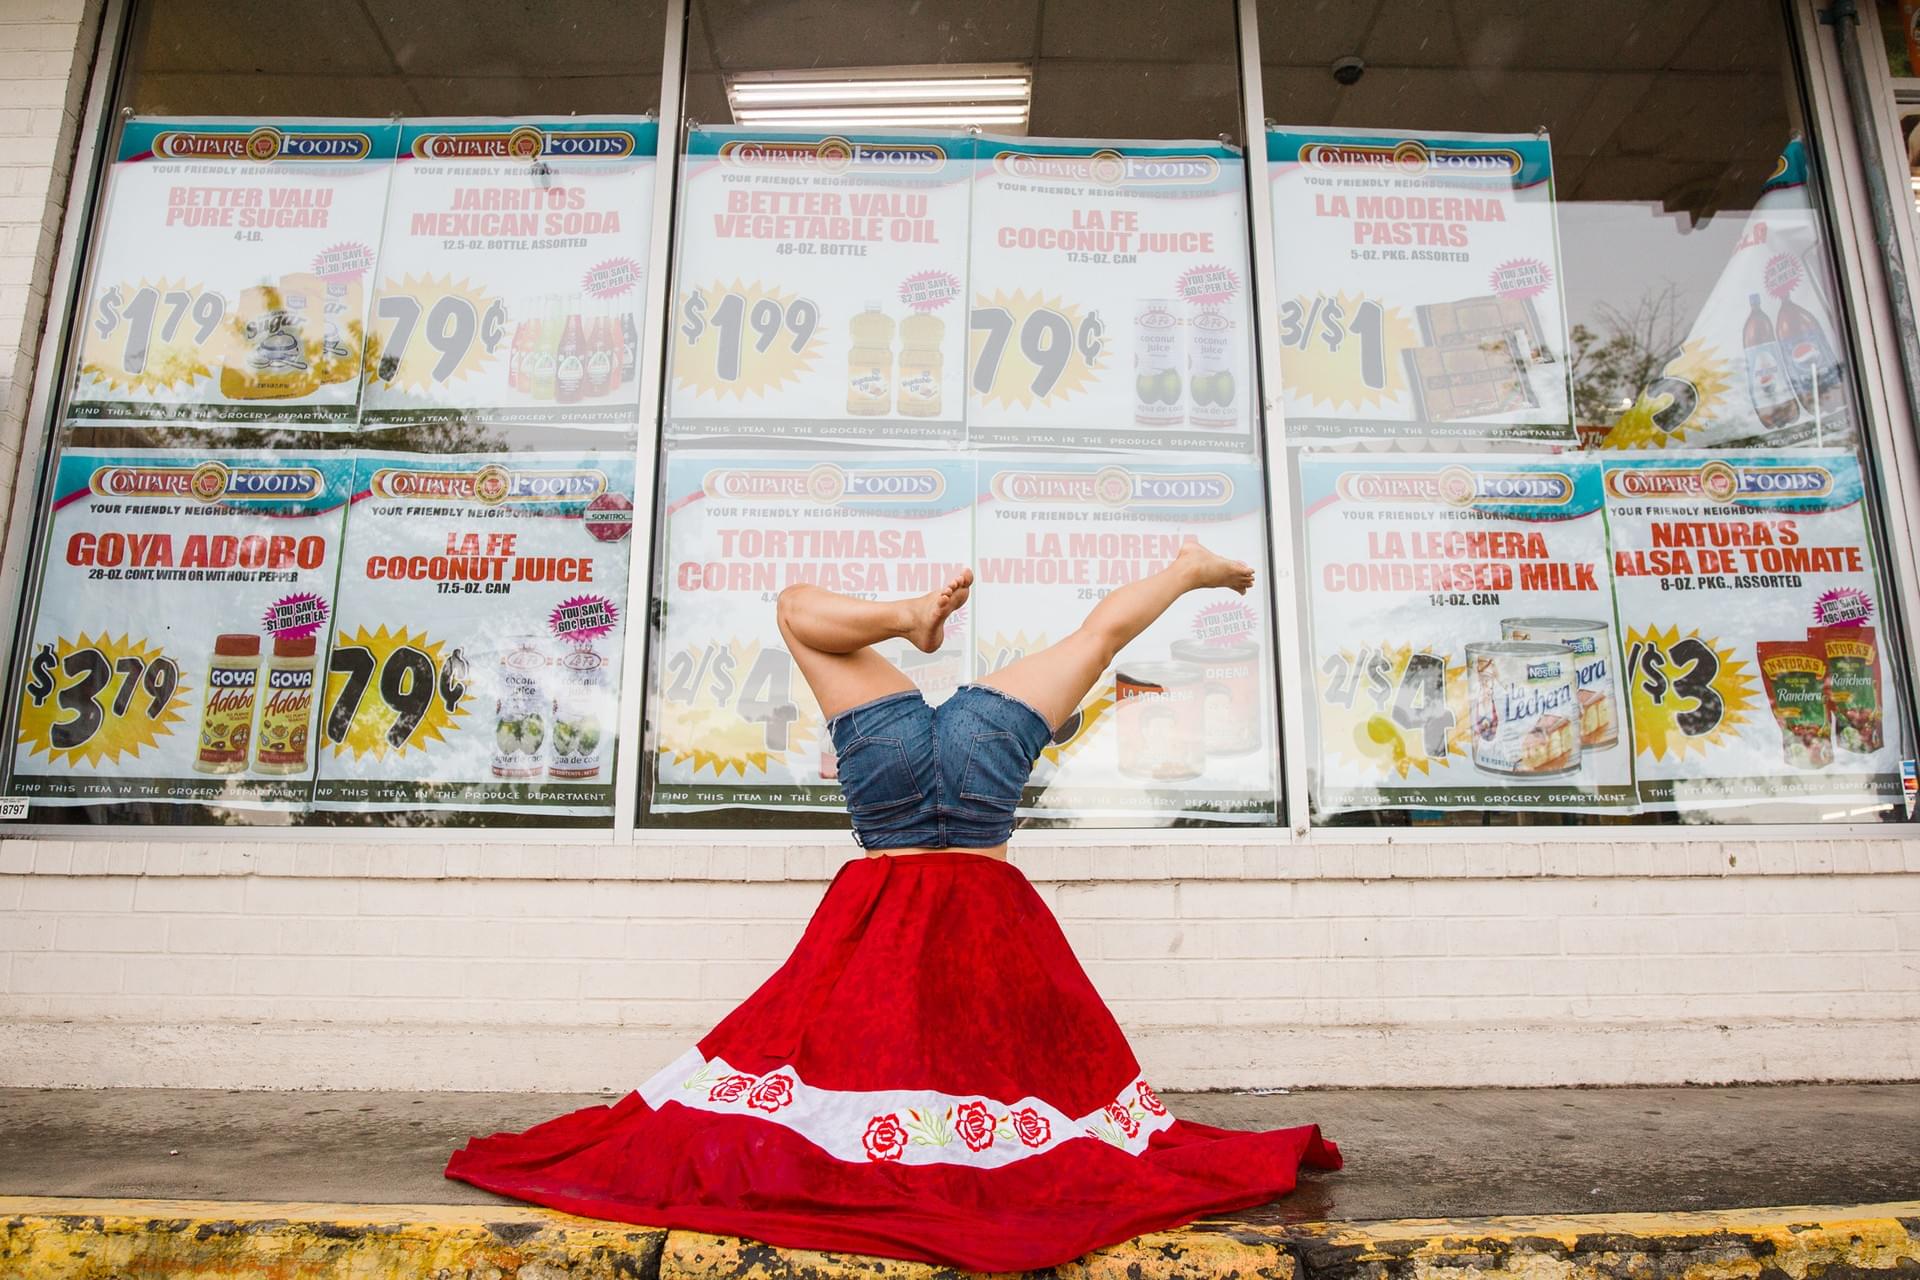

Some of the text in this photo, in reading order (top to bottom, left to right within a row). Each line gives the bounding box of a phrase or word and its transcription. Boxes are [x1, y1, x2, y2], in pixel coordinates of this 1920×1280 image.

[163, 134, 359, 157] COMPARE FOODS
[424, 134, 623, 159] COMPARE FOODS
[730, 143, 934, 166] COMPARE FOODS
[1005, 155, 1208, 180] COMPARE FOODS
[1309, 145, 1511, 170] COMPARE FOODS
[168, 187, 334, 208] BETTER VALU
[450, 188, 585, 211] JARRITOS
[728, 190, 927, 218] BETTER VALU
[1315, 194, 1506, 222] LA MODERNA
[166, 208, 328, 228] PURE SUGAR
[411, 212, 620, 236] MEXICAN SODA
[714, 214, 939, 244] VEGETABLE OIL
[1072, 210, 1138, 232] LA FE
[234, 232, 263, 242] 4-LB.
[532, 238, 587, 249] ASSORTED
[998, 228, 1214, 253] COCONUT JUICE
[1354, 222, 1468, 247] PASTAS
[776, 243, 868, 256] 48-OZ. BOTTLE
[1068, 252, 1136, 264] 17.5-OZ. CAN
[1350, 250, 1380, 260] 5-OZ.
[1411, 250, 1469, 263] ASSORTED
[101, 468, 311, 496] COMPARE FOODS
[382, 471, 596, 498] COMPARE FOODS
[714, 471, 933, 498] COMPARE FOODS
[1002, 474, 1220, 501] COMPARE FOODS
[1350, 473, 1562, 500] COMPARE FOODS
[1614, 471, 1822, 498] COMPARE FOODS
[90, 504, 180, 515] YOUR FRIENDLY
[372, 506, 462, 517] YOUR FRIENDLY
[706, 508, 799, 518] YOUR FRIENDLY
[1342, 511, 1434, 520] YOUR FRIENDLY
[1611, 507, 1698, 516] YOUR FRIENDLY
[446, 532, 517, 556] LA FE
[717, 530, 926, 558] TORTIMASA
[1651, 519, 1799, 548] NATURA'S
[66, 532, 325, 570] GOYA ADOBO
[1026, 533, 1060, 558] LA
[1368, 532, 1549, 559] LA LECHERA
[367, 556, 592, 582] COCONUT JUICE
[979, 558, 1091, 585] WHOLE
[1614, 547, 1863, 577] ALSA DE TOMATE
[156, 570, 186, 581] WITH
[188, 570, 204, 581] OR
[205, 571, 258, 582] WITHOUT
[258, 572, 298, 582] PEPPER
[678, 562, 776, 591] CORN
[785, 563, 888, 592] MASA
[1323, 563, 1599, 592] CONDENSED MILK
[1661, 578, 1696, 591] 8-OZ.
[1735, 575, 1802, 589] ASSORTED
[437, 583, 510, 594] 17.5-OZ. CAN
[1429, 594, 1500, 606] 14-OZ. CAN
[274, 600, 316, 618] YOU SAVE
[294, 612, 312, 626] PER
[560, 604, 604, 619] YOU SAVE
[580, 615, 598, 628] PER
[211, 670, 255, 685] GOYA
[271, 671, 312, 687] GOYA
[1831, 673, 1872, 686] Ranchera
[206, 688, 254, 716] Adobo
[264, 688, 311, 717] Adobo
[1505, 684, 1571, 720] Lechera
[1777, 688, 1824, 702] Ranchera
[84, 784, 112, 793] ITEM
[120, 785, 132, 794] IN
[139, 786, 159, 794] THE
[167, 787, 222, 796] GROCERY
[340, 788, 606, 801] THIS ITEM IN THE PRODUCE DEPARTMENT
[662, 792, 762, 802] FIND THIS ITEM
[1363, 794, 1627, 803] THIS ITEM IN THE GROCERY DEPARTMENT
